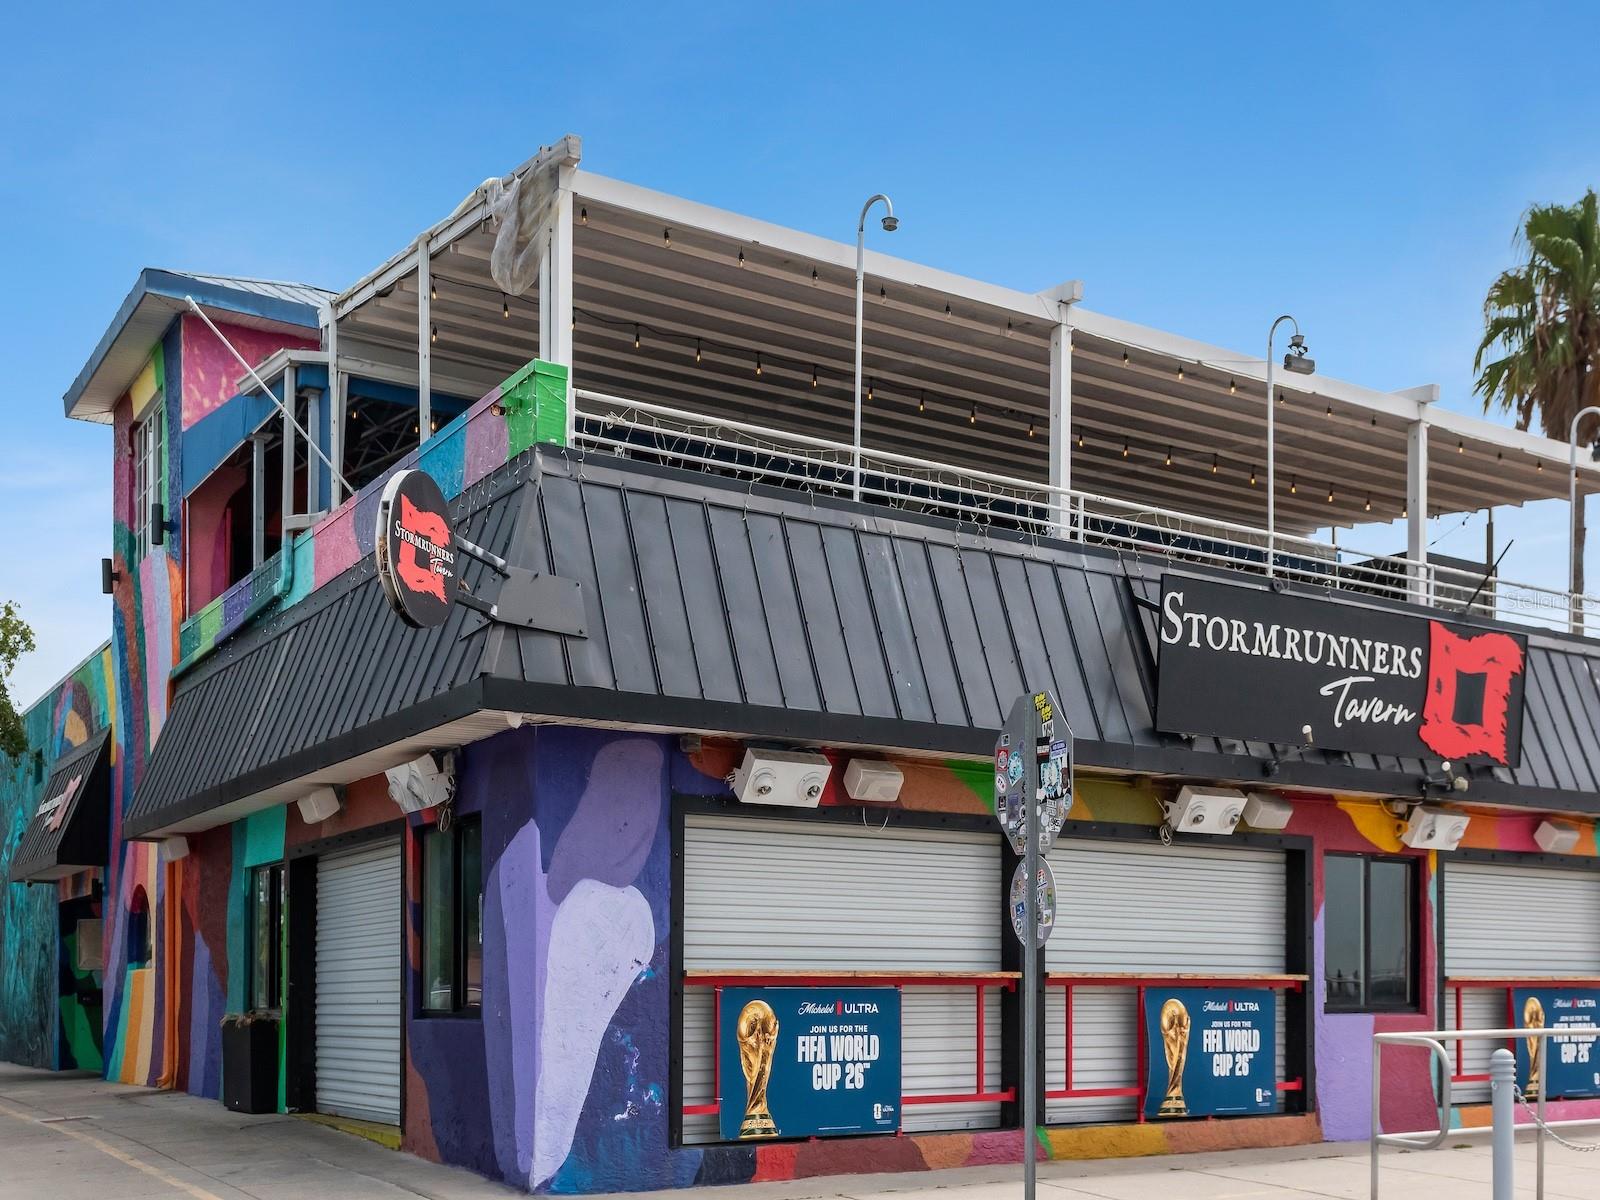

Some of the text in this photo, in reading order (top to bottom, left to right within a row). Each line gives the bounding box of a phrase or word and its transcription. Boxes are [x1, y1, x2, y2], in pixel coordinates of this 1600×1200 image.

[394, 519, 455, 564] STORMRUNNERS
[430, 558, 454, 578] Tavern
[1160, 591, 1423, 679] STORMRUNNERS
[1319, 675, 1418, 728] Tavern
[797, 1001, 879, 1016] Michelob ULTRA
[1234, 1002, 1260, 1012] ULTRA
[809, 1024, 868, 1034] JOIN US FOR THE
[1211, 1020, 1252, 1028] JOIN US FOR THE
[797, 1034, 880, 1063] FIFA WORLD
[1202, 1029, 1260, 1053] FIFA WORLD
[812, 1063, 842, 1091] CUP
[1212, 1053, 1234, 1077] CUP
